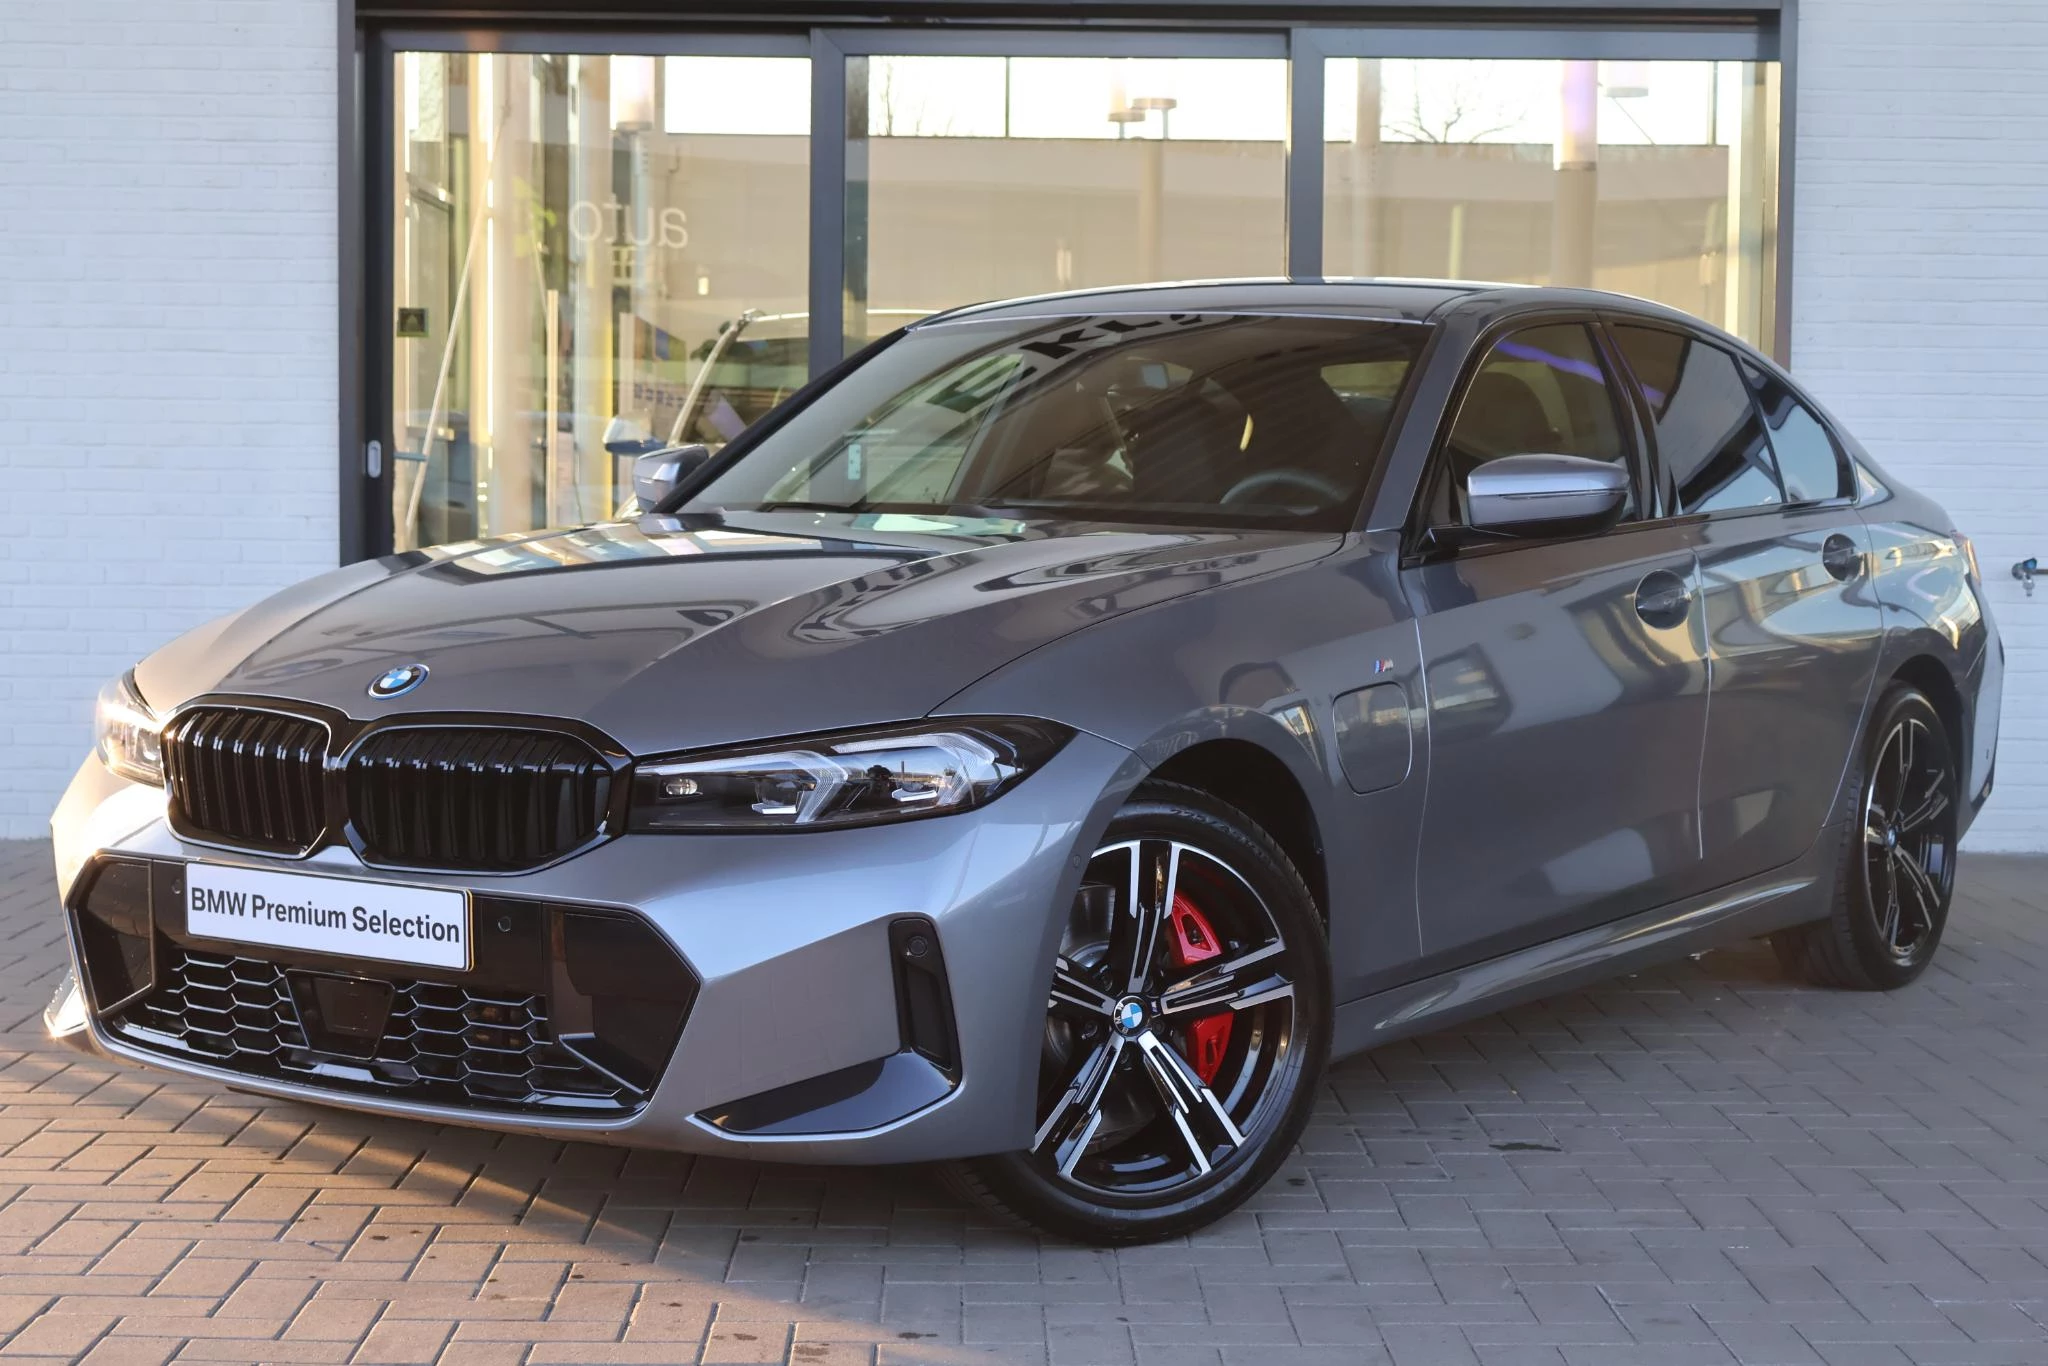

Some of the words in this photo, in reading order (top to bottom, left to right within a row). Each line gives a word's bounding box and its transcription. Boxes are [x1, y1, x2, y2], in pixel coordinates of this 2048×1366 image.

[192, 887, 247, 917] BMW
[252, 894, 347, 930] Premium
[352, 906, 460, 943] Selection
